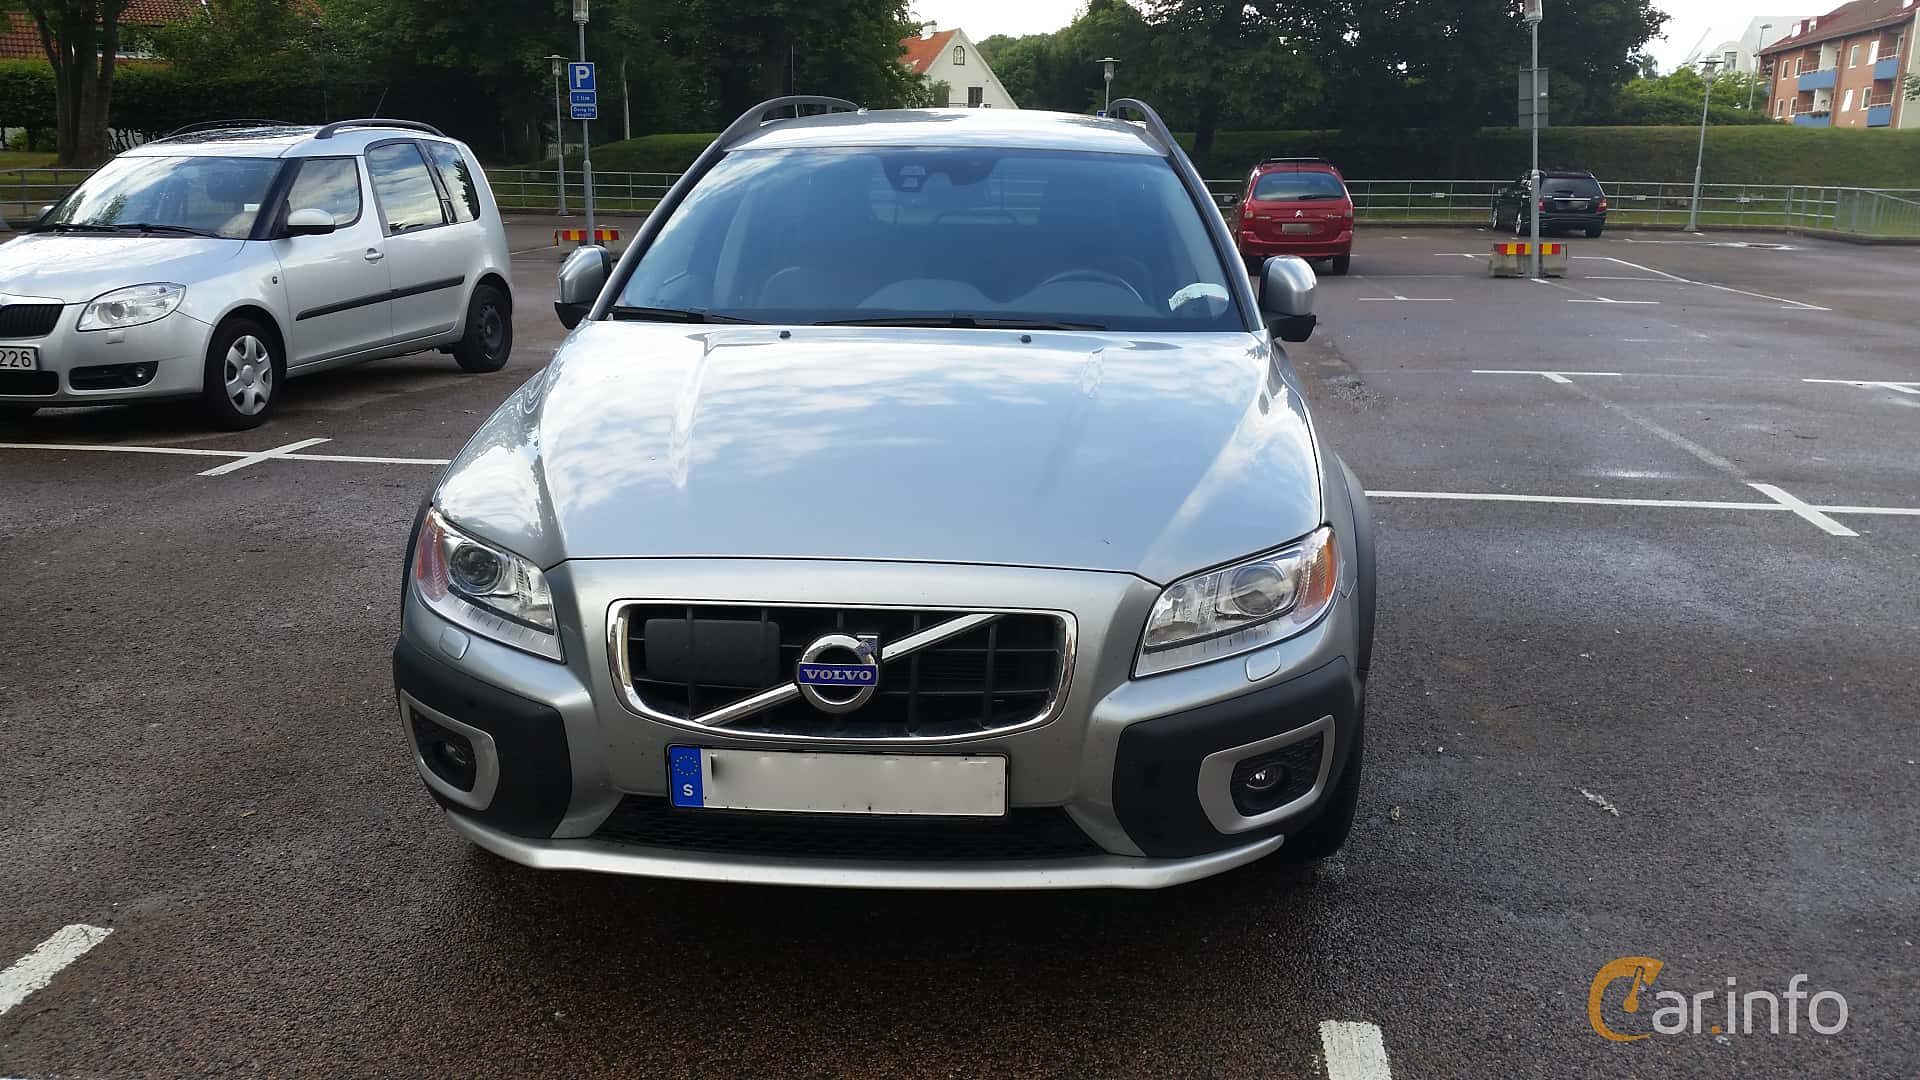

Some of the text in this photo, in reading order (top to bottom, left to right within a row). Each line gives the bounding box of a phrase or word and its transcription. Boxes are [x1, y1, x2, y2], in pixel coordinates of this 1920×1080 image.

[575, 65, 590, 87] P
[803, 669, 872, 681] VOLVO
[683, 783, 694, 797] S
